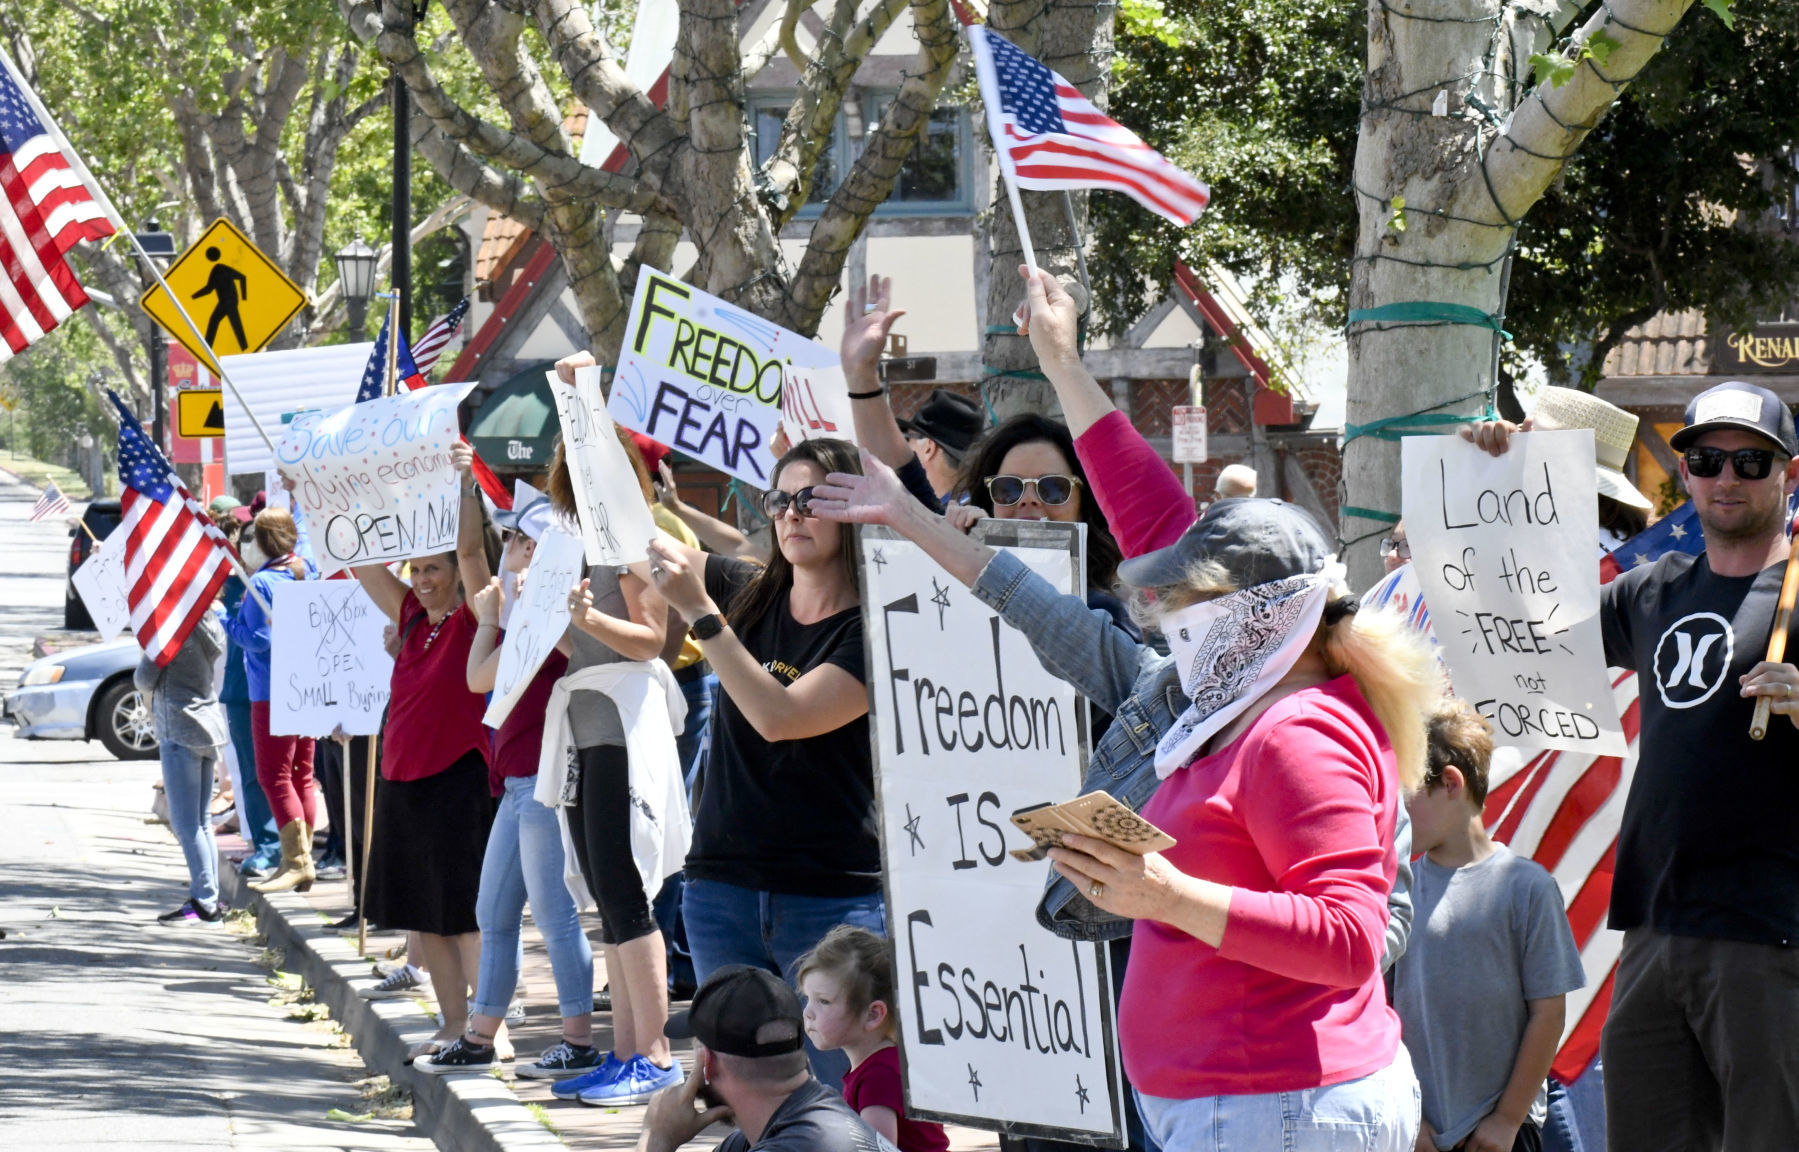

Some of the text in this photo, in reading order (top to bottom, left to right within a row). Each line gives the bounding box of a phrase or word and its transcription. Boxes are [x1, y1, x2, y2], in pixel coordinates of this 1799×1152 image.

[696, 384, 753, 413] over
[278, 408, 448, 465] Save our
[507, 440, 534, 460] The
[646, 381, 766, 481] FEAR
[303, 463, 385, 512] dying
[377, 453, 457, 485] economy
[1440, 458, 1560, 530] Land
[325, 511, 416, 561] OPEN
[1443, 547, 1558, 595] of the
[1475, 612, 1552, 655] FREE
[317, 654, 365, 677] OPEN
[883, 592, 1066, 756] Freedom
[1513, 672, 1547, 690] not
[287, 672, 338, 712] SMALL
[1475, 699, 1600, 741] FORCED
[946, 790, 1006, 870] IS
[907, 908, 1092, 1059] Essential
